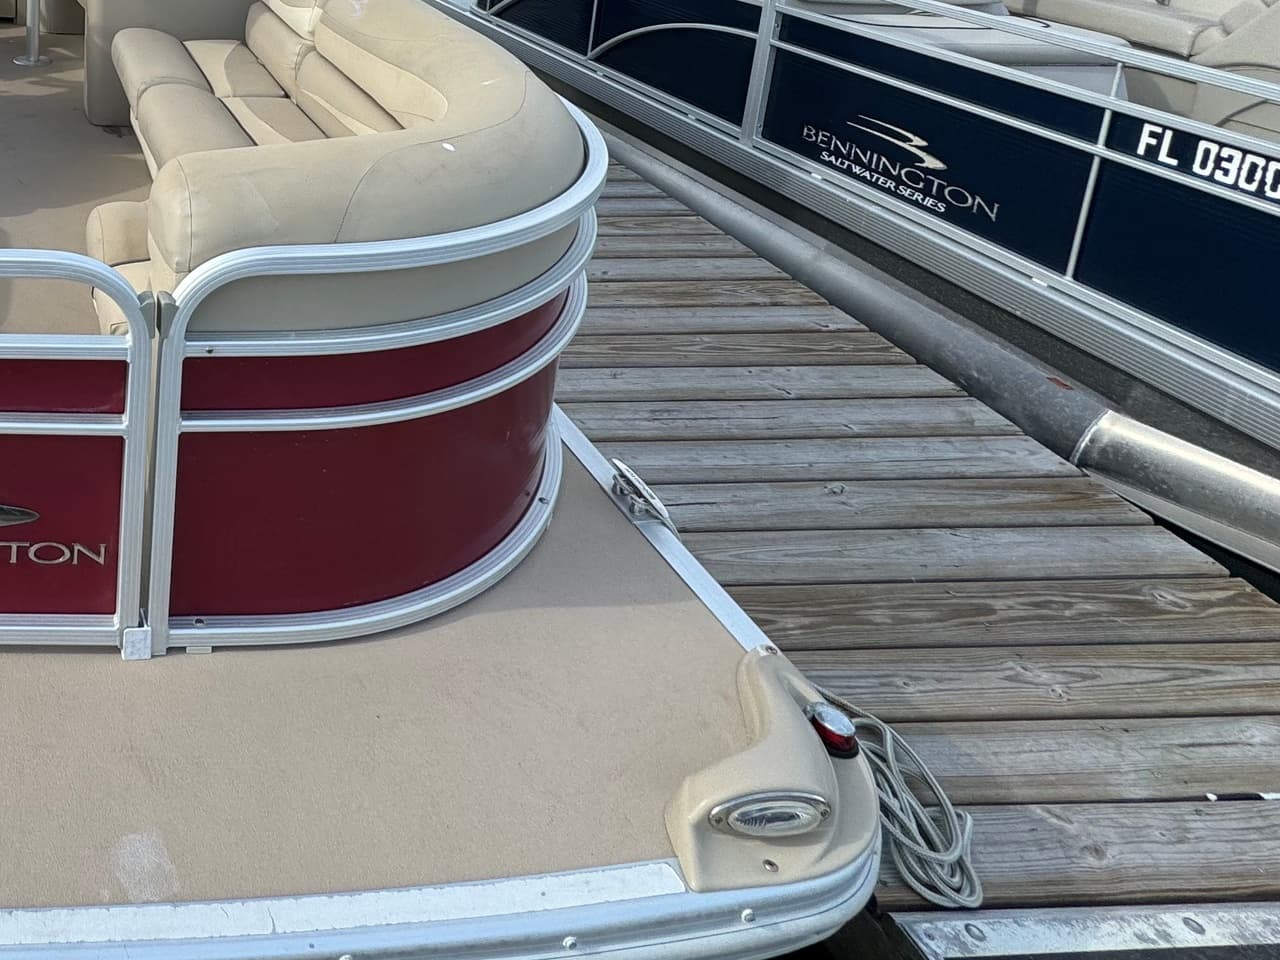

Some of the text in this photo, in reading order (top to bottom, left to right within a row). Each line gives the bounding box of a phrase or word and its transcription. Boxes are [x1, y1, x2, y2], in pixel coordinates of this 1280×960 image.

[802, 123, 1000, 223] BENNINGTON
[1136, 122, 1179, 166] FL
[820, 151, 947, 213] SALTWATER SERIES
